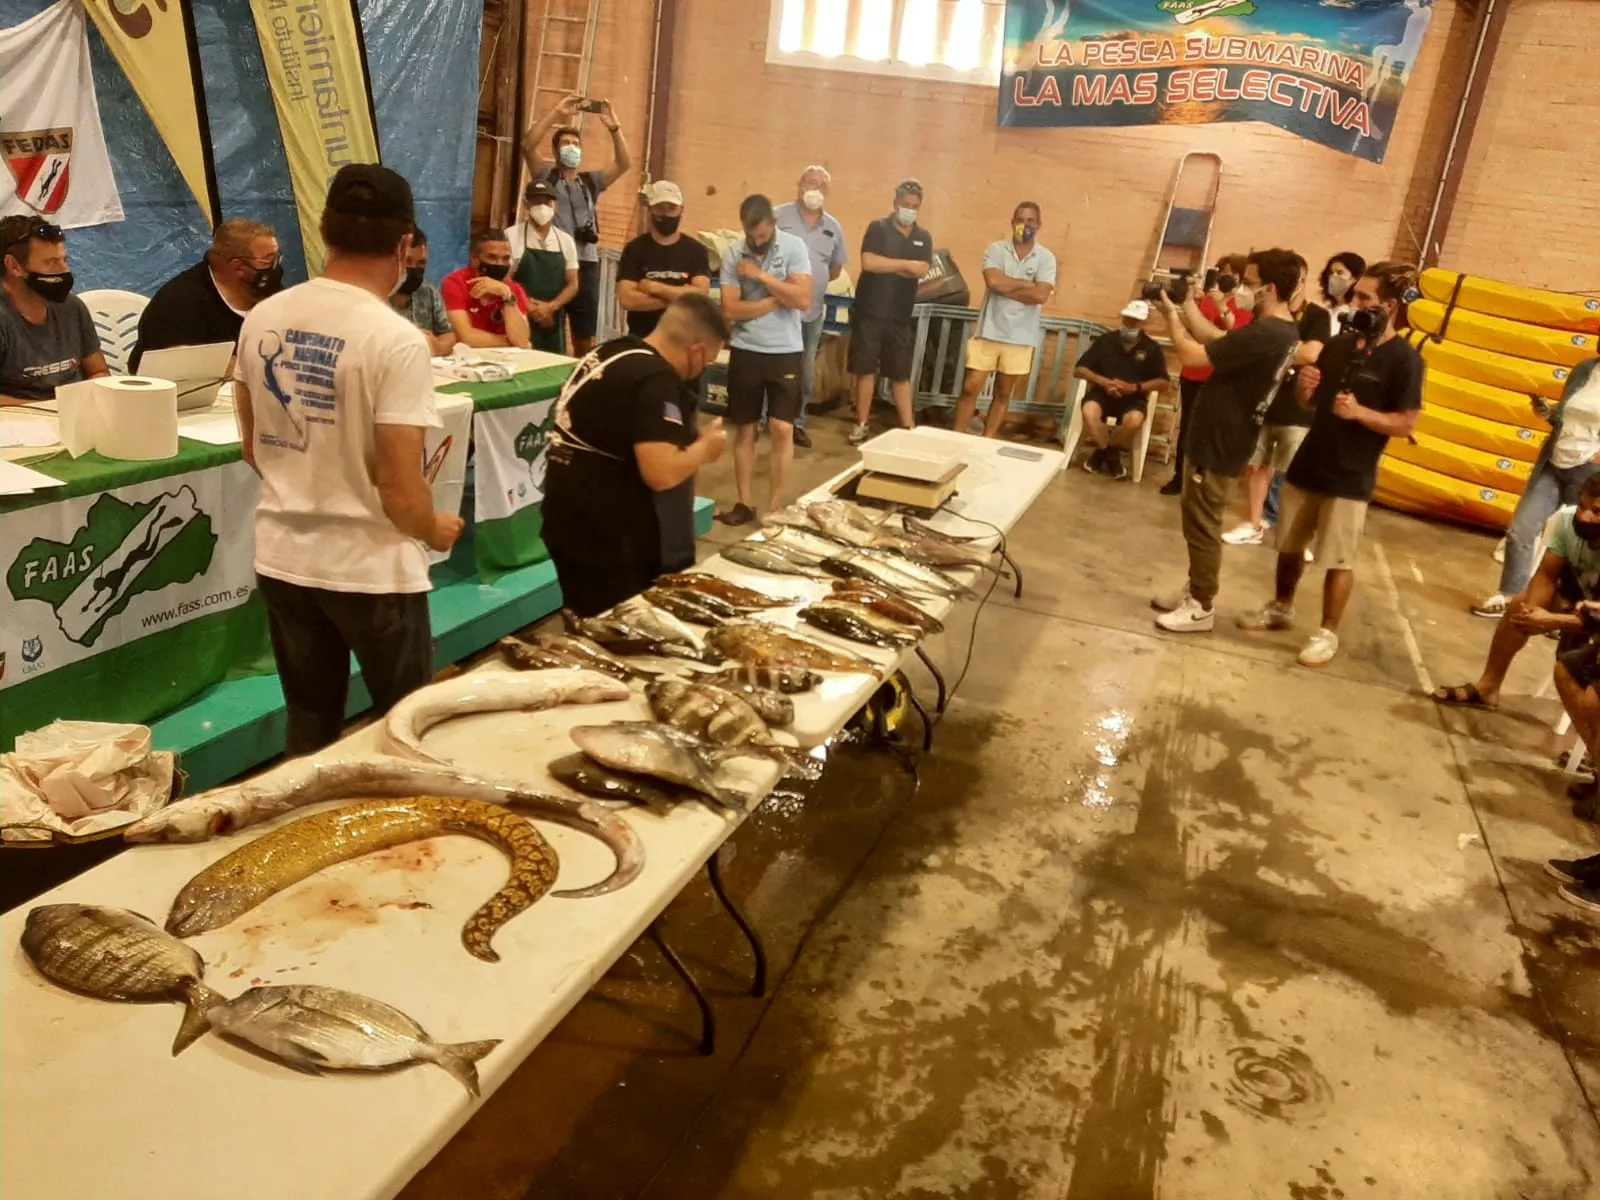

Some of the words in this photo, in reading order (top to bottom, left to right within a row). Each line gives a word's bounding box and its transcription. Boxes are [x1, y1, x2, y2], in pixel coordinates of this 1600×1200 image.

[1162, 1, 1194, 9] FAAS
[1038, 43, 1074, 66] LA
[1082, 38, 1177, 66] PESCA
[1183, 36, 1366, 90] SUBMARINA
[1014, 75, 1062, 106] LA
[1072, 72, 1158, 106] MAS
[1166, 67, 1370, 137] SELECTIVA
[2, 133, 70, 154] FEDAS
[24, 545, 95, 589] FAAS
[141, 585, 249, 628] www.fass.com.es
